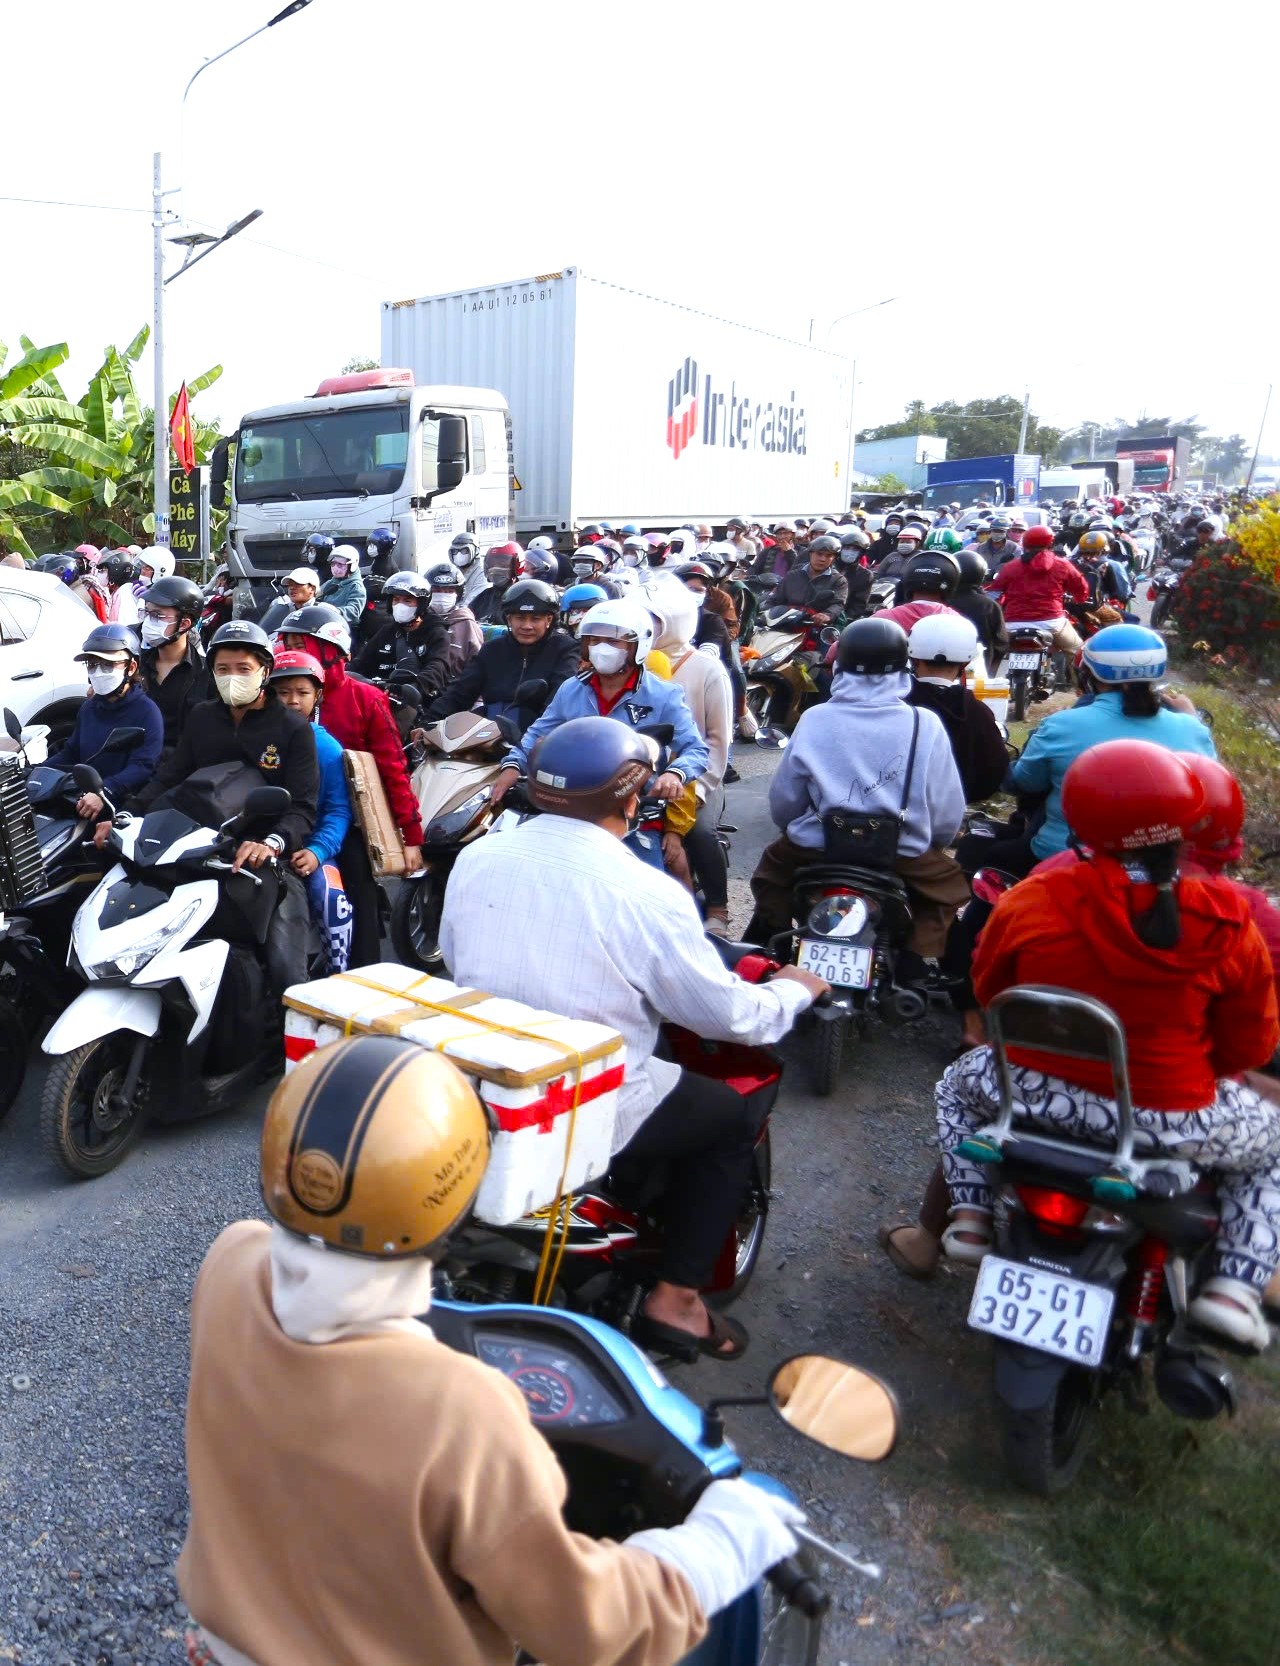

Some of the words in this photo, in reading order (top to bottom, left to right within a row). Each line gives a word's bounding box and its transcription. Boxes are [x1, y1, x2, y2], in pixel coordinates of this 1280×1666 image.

[702, 373, 807, 456] Interasia
[171, 474, 191, 494] Cà
[170, 502, 195, 521] Phê
[809, 944, 859, 966] 62-E1
[1029, 1256, 1072, 1274] HONDA
[997, 1268, 1087, 1318] 65-G1
[978, 1296, 1094, 1355] 397.46
